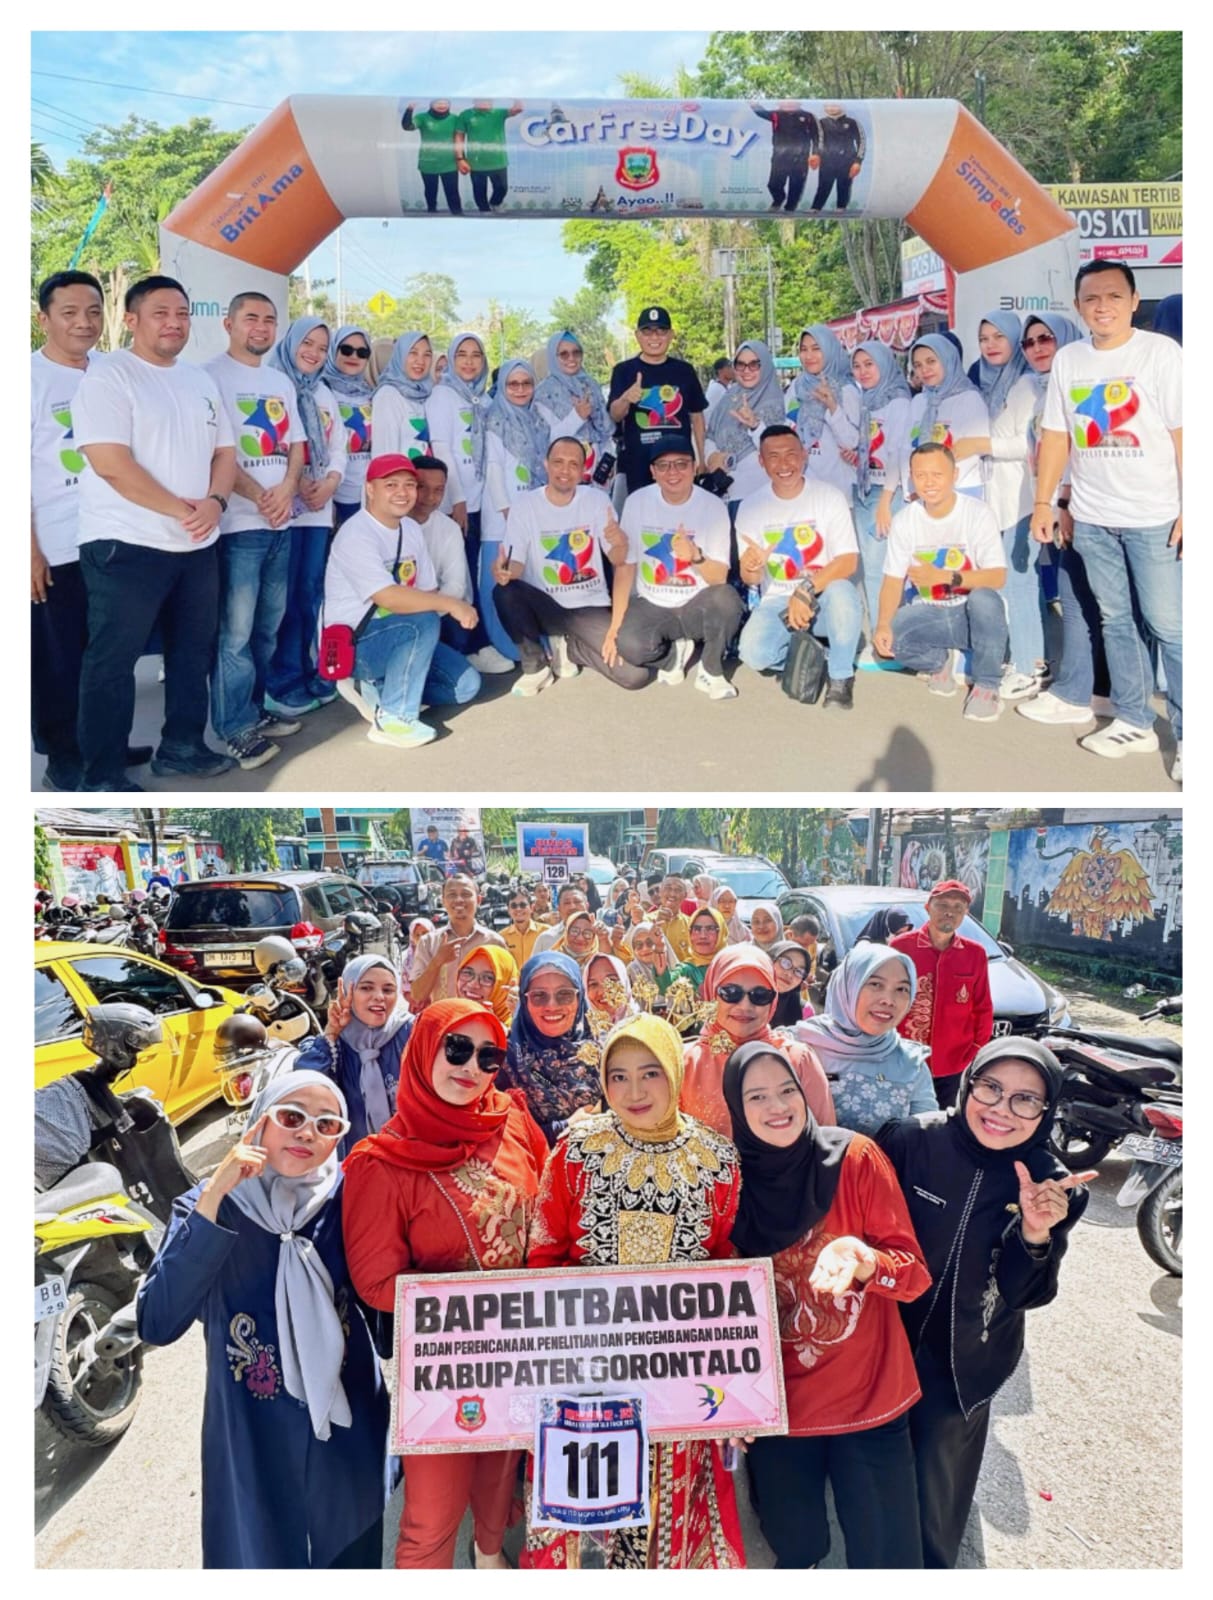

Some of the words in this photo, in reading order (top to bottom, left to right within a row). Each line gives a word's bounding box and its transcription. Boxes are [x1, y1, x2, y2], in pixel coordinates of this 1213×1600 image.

[520, 113, 760, 158] CarFreeDay
[219, 164, 304, 243] BritAma
[955, 161, 1026, 236] Simpedes
[1057, 188, 1129, 205] KAWASAN
[1132, 187, 1181, 203] TERTIB
[1111, 208, 1149, 237] KTL
[546, 865, 566, 879] 128
[414, 1281, 756, 1334] BAPELITBANGDA
[415, 1341, 452, 1357] BADAN
[538, 1334, 599, 1351] PENELITIAN
[600, 1332, 623, 1348] DAN
[625, 1327, 713, 1346] PENGEMBANGAN
[714, 1325, 758, 1341] DAERAH
[414, 1357, 585, 1391] KABUPATEN
[590, 1346, 761, 1383] GORONTALO
[562, 1441, 619, 1499] 111
